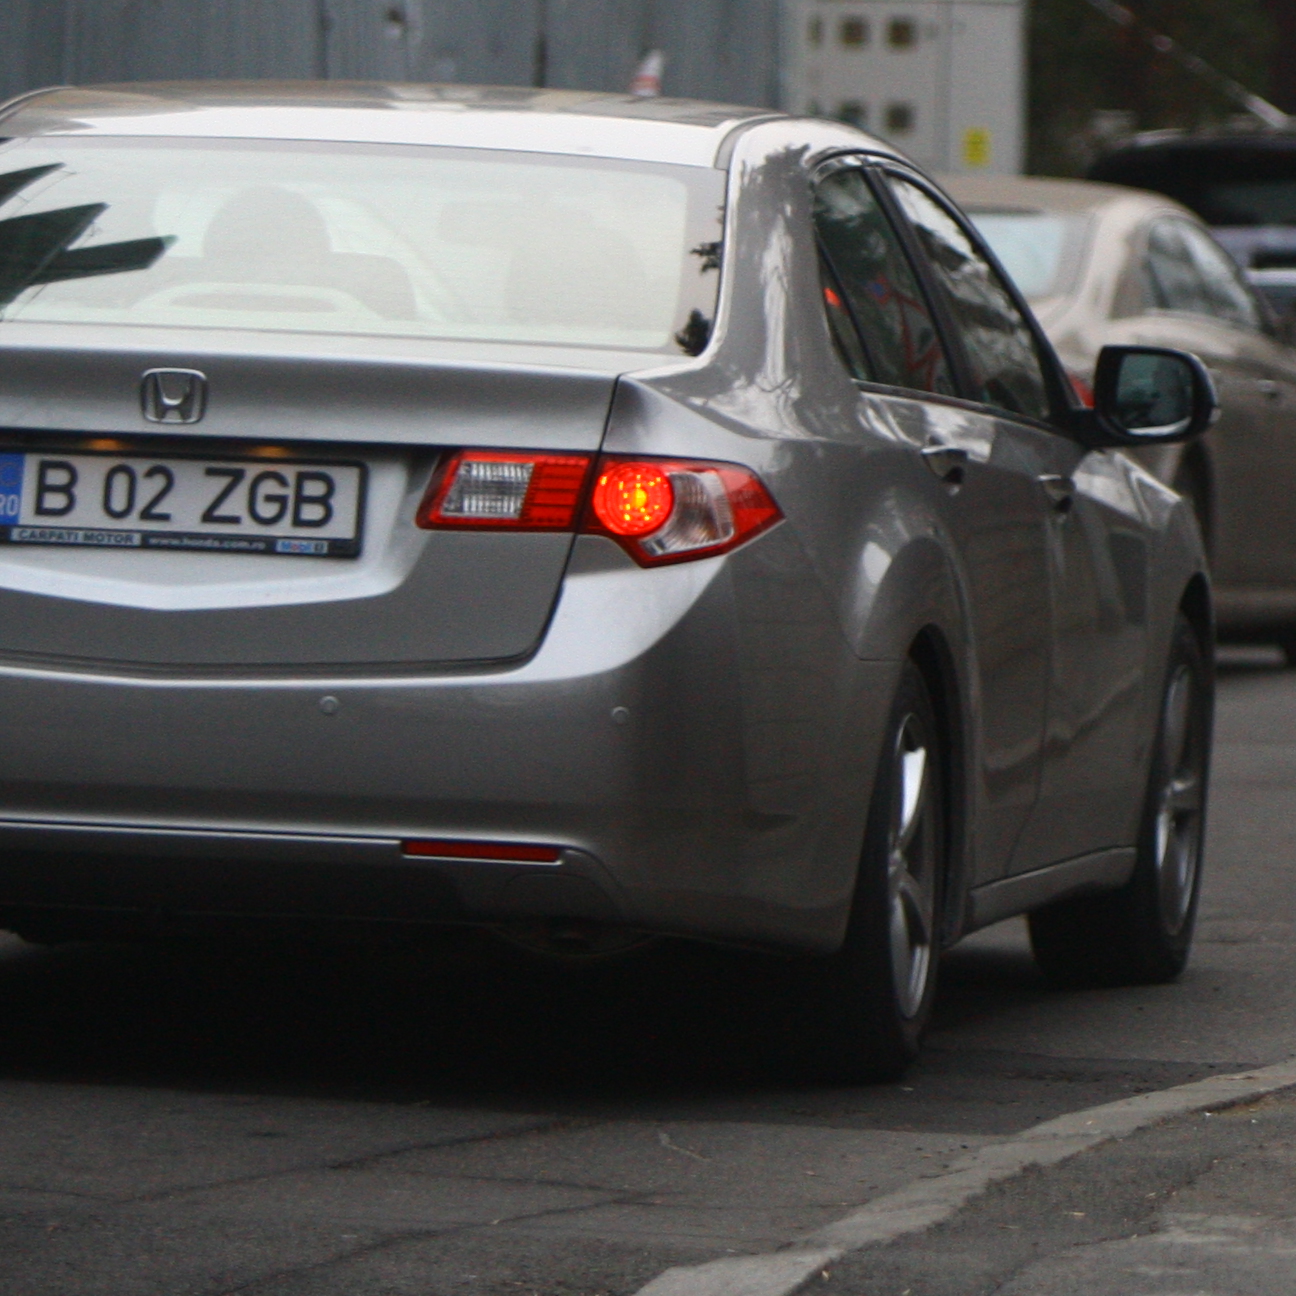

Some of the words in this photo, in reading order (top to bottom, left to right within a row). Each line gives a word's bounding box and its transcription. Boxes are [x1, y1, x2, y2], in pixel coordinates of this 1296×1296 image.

[34, 460, 78, 517] B
[103, 463, 175, 521] 02
[201, 466, 337, 528] ZGB
[83, 532, 134, 544] MOTOR
